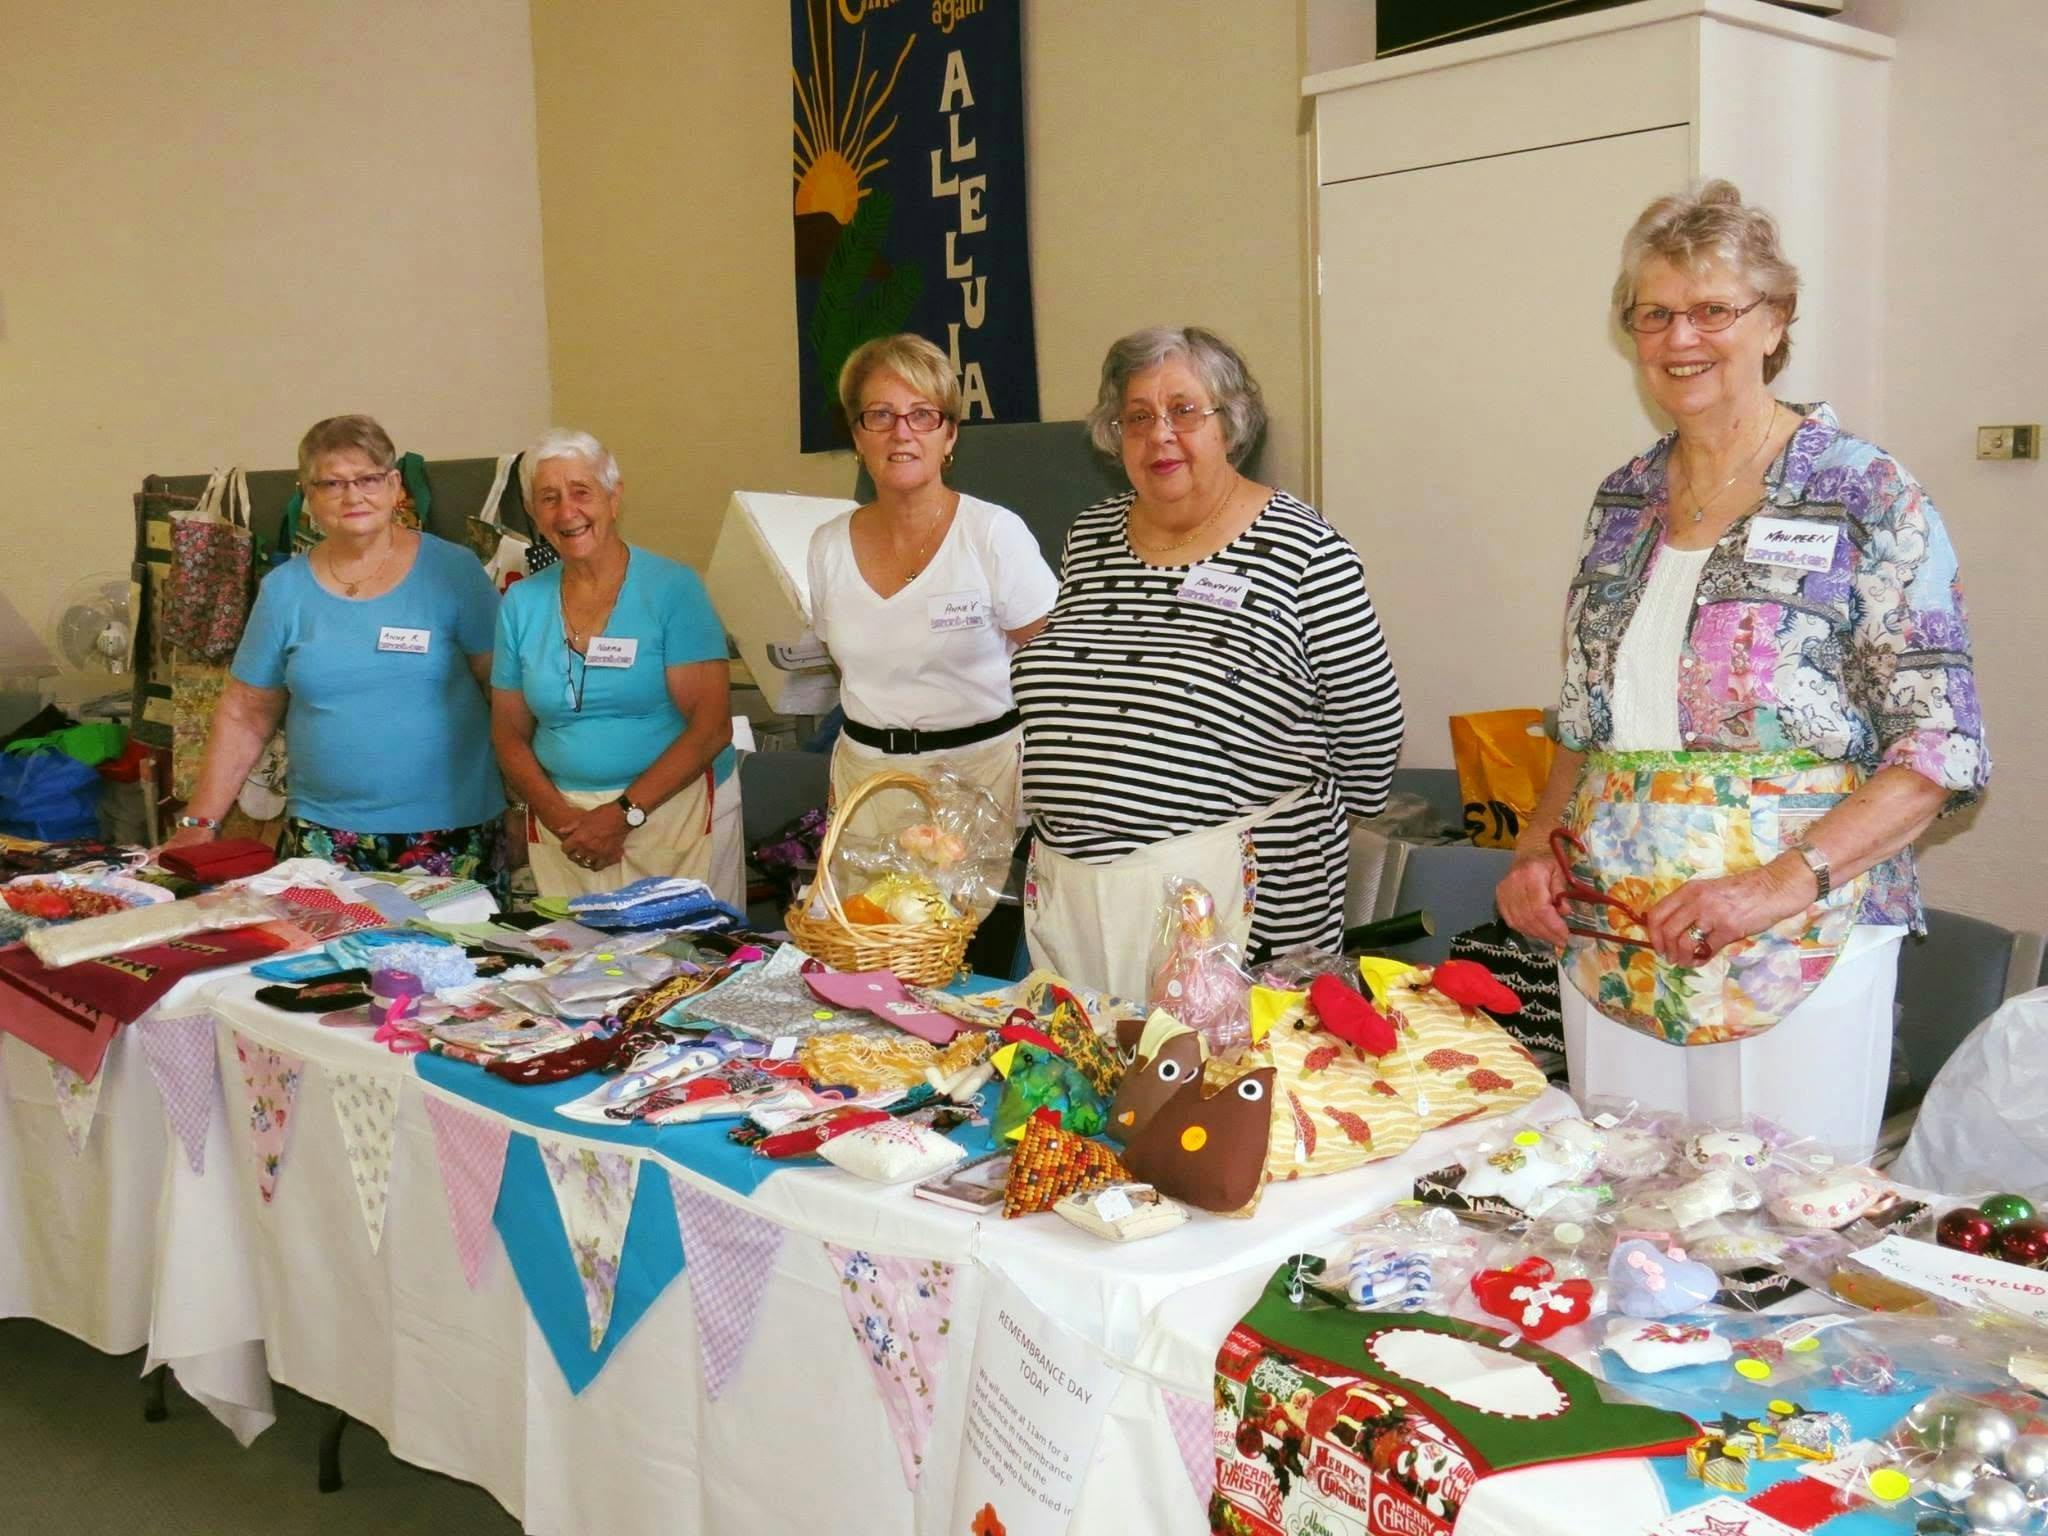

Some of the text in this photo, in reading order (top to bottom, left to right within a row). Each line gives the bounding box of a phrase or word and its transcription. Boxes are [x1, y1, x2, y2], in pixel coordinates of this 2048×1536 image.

[931, 50, 994, 419] ALLELUIA
[1765, 530, 1833, 543] MAUREEN
[1951, 1274, 2045, 1296] RECYCLED
[999, 1310, 1092, 1405] REMEMBRANCE DAY
[1020, 1359, 1050, 1397] TODAY
[999, 1393, 1018, 1416] pause
[1026, 1420, 1046, 1445] 11am
[1047, 1439, 1061, 1456] for
[993, 1426, 1022, 1465] members
[1023, 1460, 1033, 1473] of
[1032, 1467, 1047, 1486] the
[1015, 1431, 1073, 1483] remembrance
[1003, 1459, 1018, 1479] who
[1018, 1473, 1037, 1496] have
[1038, 1492, 1062, 1512] died
